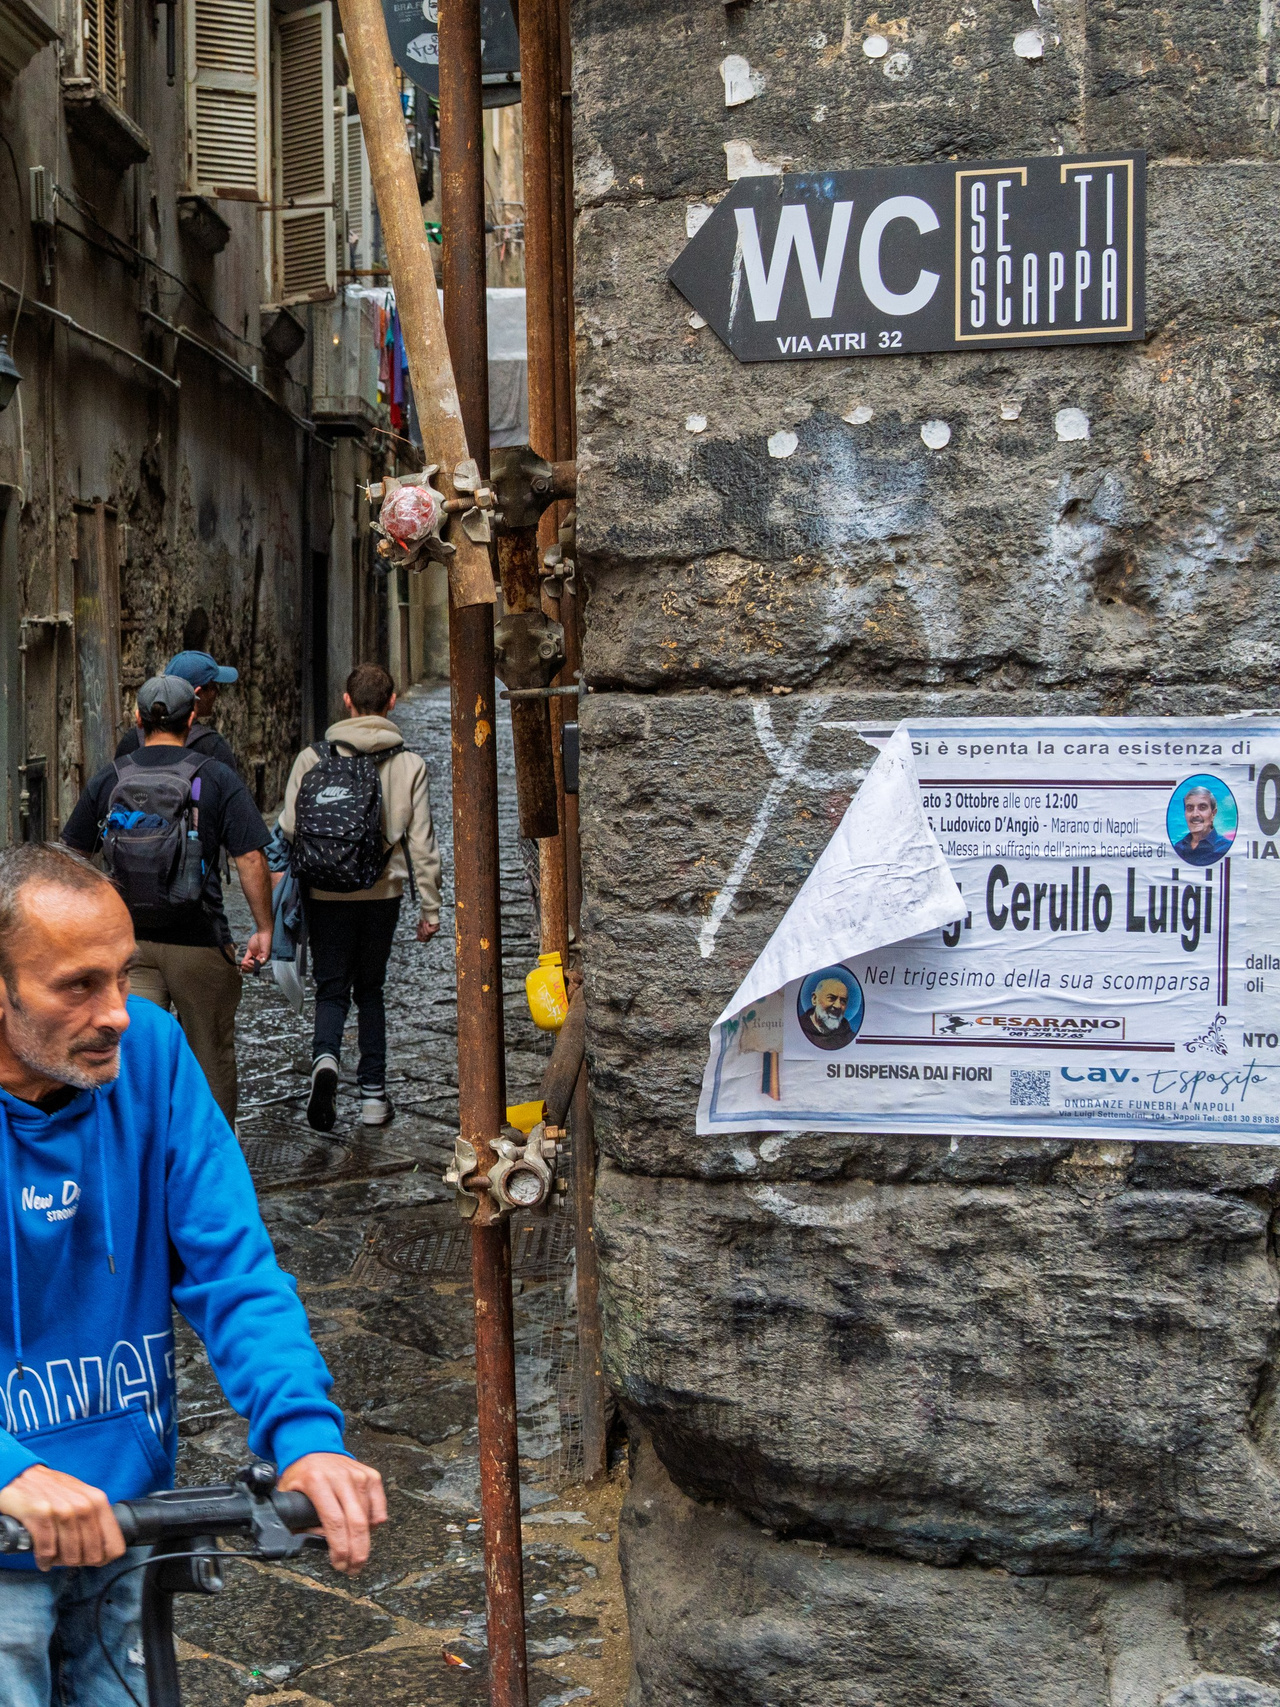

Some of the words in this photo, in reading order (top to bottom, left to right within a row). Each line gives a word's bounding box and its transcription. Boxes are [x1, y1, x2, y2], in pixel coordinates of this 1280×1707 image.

[971, 180, 1012, 253] SE
[1074, 173, 1114, 247] TI
[733, 195, 940, 322] WC
[971, 248, 1116, 328] SCAPPA
[776, 336, 813, 354] VIA
[817, 332, 866, 352] ATRI
[878, 330, 902, 348] 32
[911, 741, 929, 755] Si
[937, 740, 949, 755] è
[957, 743, 1029, 759] spenta
[1037, 740, 1055, 754] la
[1063, 743, 1110, 754] cara
[1118, 741, 1222, 755] esistenza
[1231, 740, 1251, 755] di
[322, 786, 350, 797] NIKE
[944, 792, 952, 808] 3
[955, 792, 999, 808] Ottobre
[1003, 792, 1020, 808] alle
[1024, 796, 1041, 809] ore
[1045, 793, 1078, 809] 12:00
[940, 816, 990, 833] Ludovico
[995, 815, 1039, 836] D'Angiò
[1051, 818, 1090, 833] Marano
[1093, 818, 1103, 833] di
[1106, 818, 1139, 838] Napoli
[947, 841, 978, 856] Messa
[982, 841, 992, 856] in
[995, 841, 1040, 860] suffragio
[1043, 841, 1097, 858] dell'anima
[1101, 842, 1153, 858] benedetta
[1157, 843, 1166, 858] di
[986, 864, 1113, 932] Cerullo
[1126, 867, 1213, 952] Luigi
[1246, 954, 1280, 970] dalla
[864, 966, 895, 985] Nel
[903, 967, 995, 990] trigesimo
[1004, 968, 1051, 988] della
[1060, 973, 1093, 989] sua
[1102, 973, 1210, 995] scomparsa
[975, 1016, 1121, 1029] CESARANO
[826, 1063, 841, 1079] SI
[845, 1064, 920, 1080] DISPENSA
[923, 1066, 948, 1081] DAI
[952, 1066, 992, 1082] FIORI
[1064, 1099, 1123, 1109] ONORANZE
[1129, 1100, 1176, 1111] FUNEBRI
[1182, 1102, 1188, 1111] A
[1194, 1102, 1235, 1112] NAPOLI
[1074, 1111, 1095, 1119] Luigi
[1173, 1113, 1200, 1122] Napoli
[1240, 1115, 1250, 1123] 30
[21, 1185, 53, 1211] New
